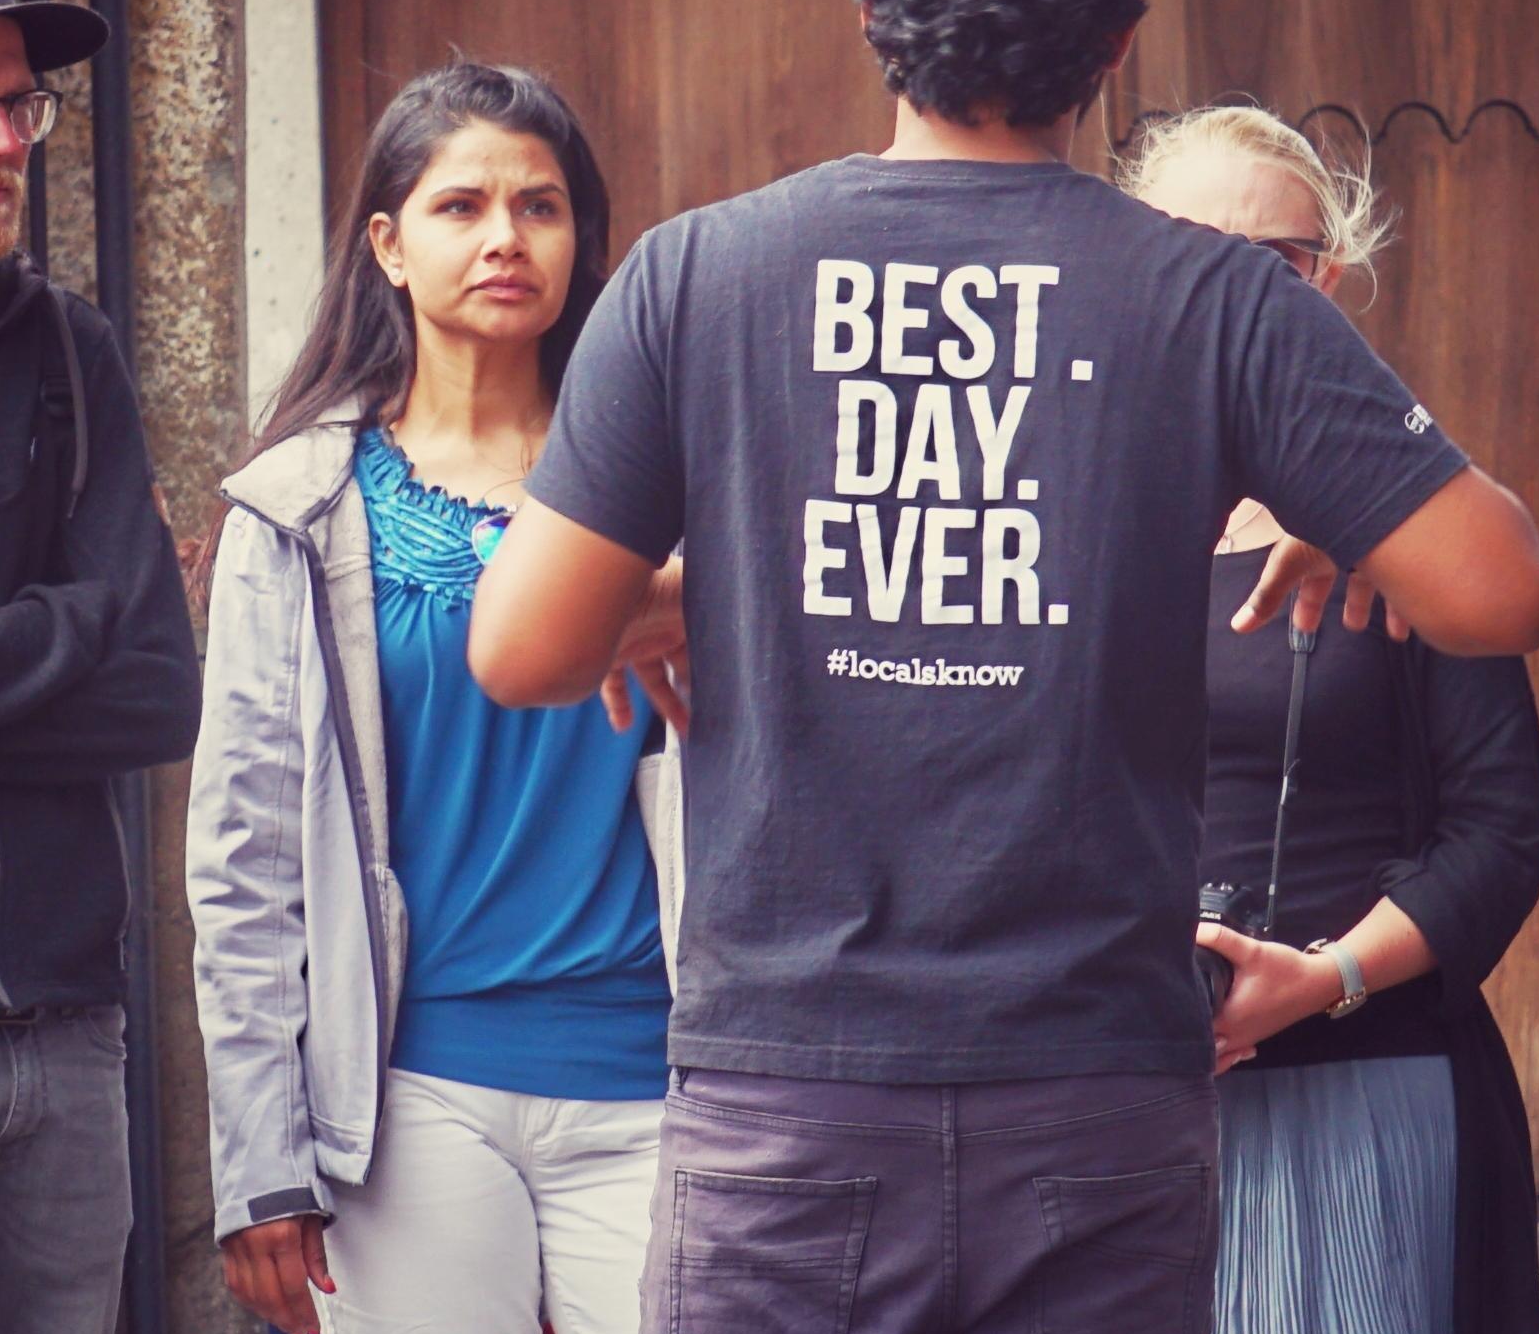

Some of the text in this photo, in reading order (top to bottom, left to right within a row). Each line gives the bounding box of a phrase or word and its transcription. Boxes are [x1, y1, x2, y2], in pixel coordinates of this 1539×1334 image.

[834, 379, 1040, 501] DAY.
[802, 498, 1070, 626] EVER.
[826, 648, 1025, 687] #localsknow
